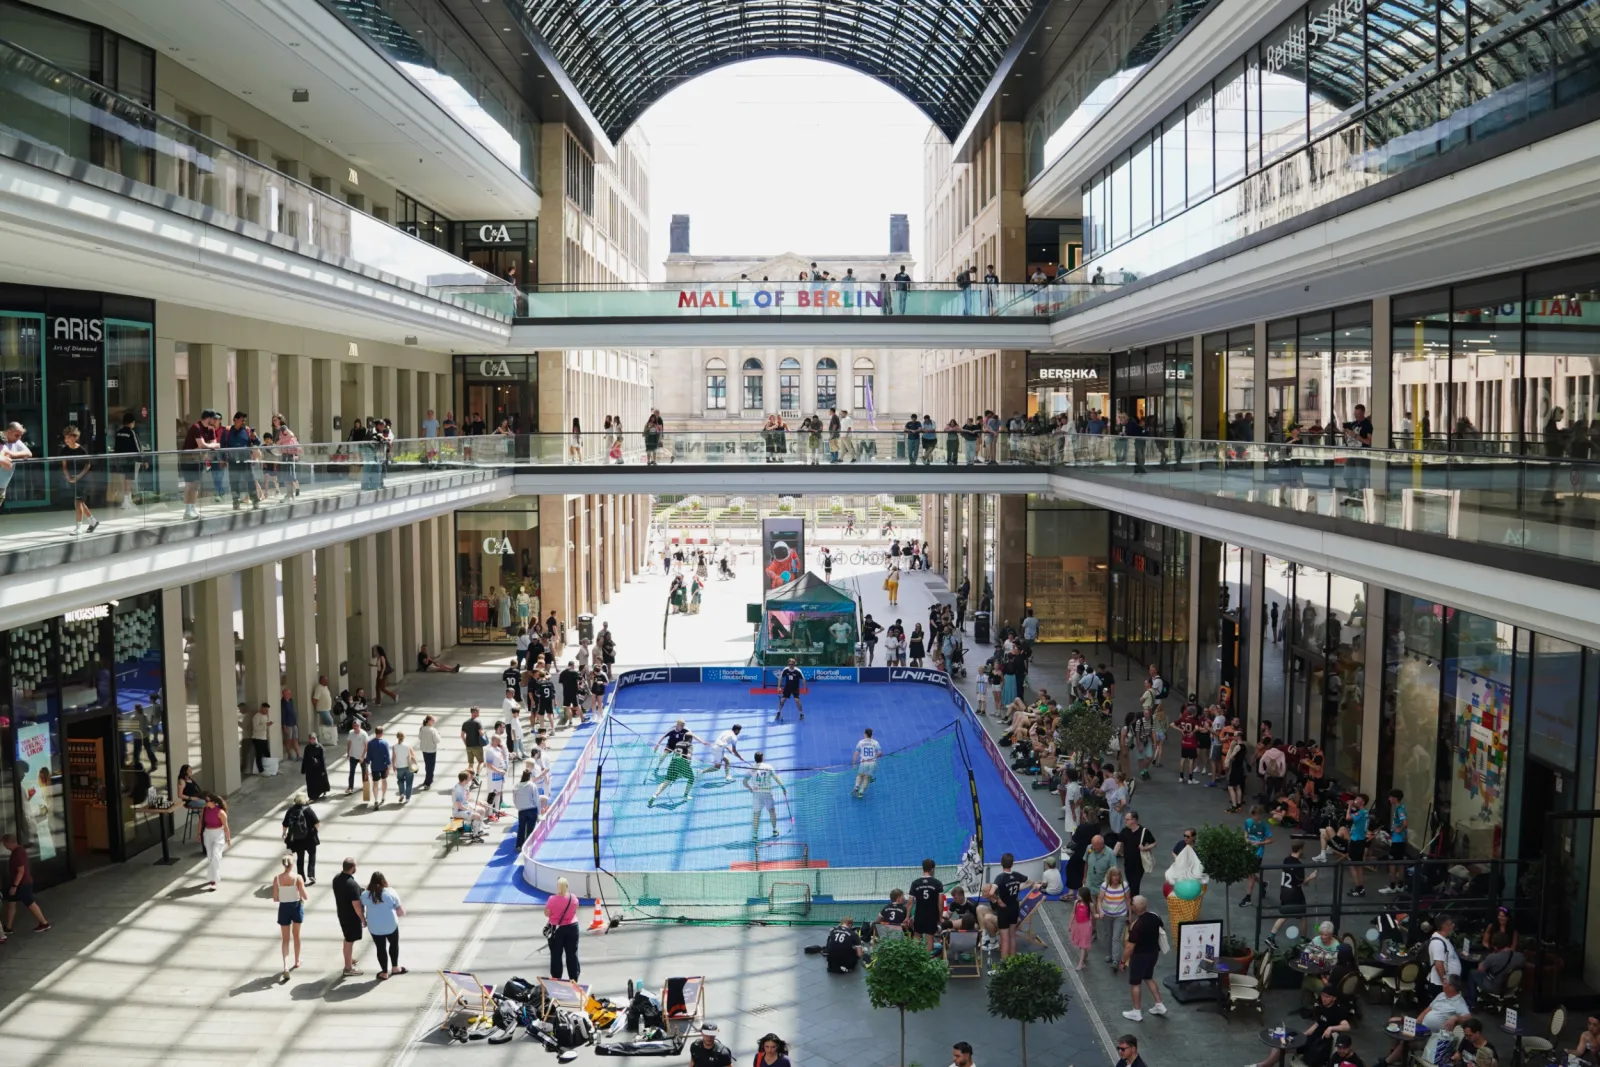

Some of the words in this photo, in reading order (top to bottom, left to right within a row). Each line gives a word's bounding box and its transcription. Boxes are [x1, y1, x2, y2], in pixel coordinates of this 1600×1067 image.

[479, 224, 511, 242] C&A
[678, 290, 742, 308] MALL
[754, 290, 785, 308] OF
[798, 290, 883, 308] BERLIN
[479, 359, 512, 377] C&A
[1039, 369, 1098, 379] BERSHKA
[482, 537, 515, 554] C&A
[507, 678, 516, 686] 10
[891, 670, 947, 685] UNIHOC
[543, 688, 550, 698] 9
[864, 747, 873, 757] 66
[1281, 871, 1292, 889] 12
[922, 890, 929, 900] 5
[1008, 886, 1018, 896] 12
[889, 911, 896, 921] 3
[834, 933, 846, 943] 16
